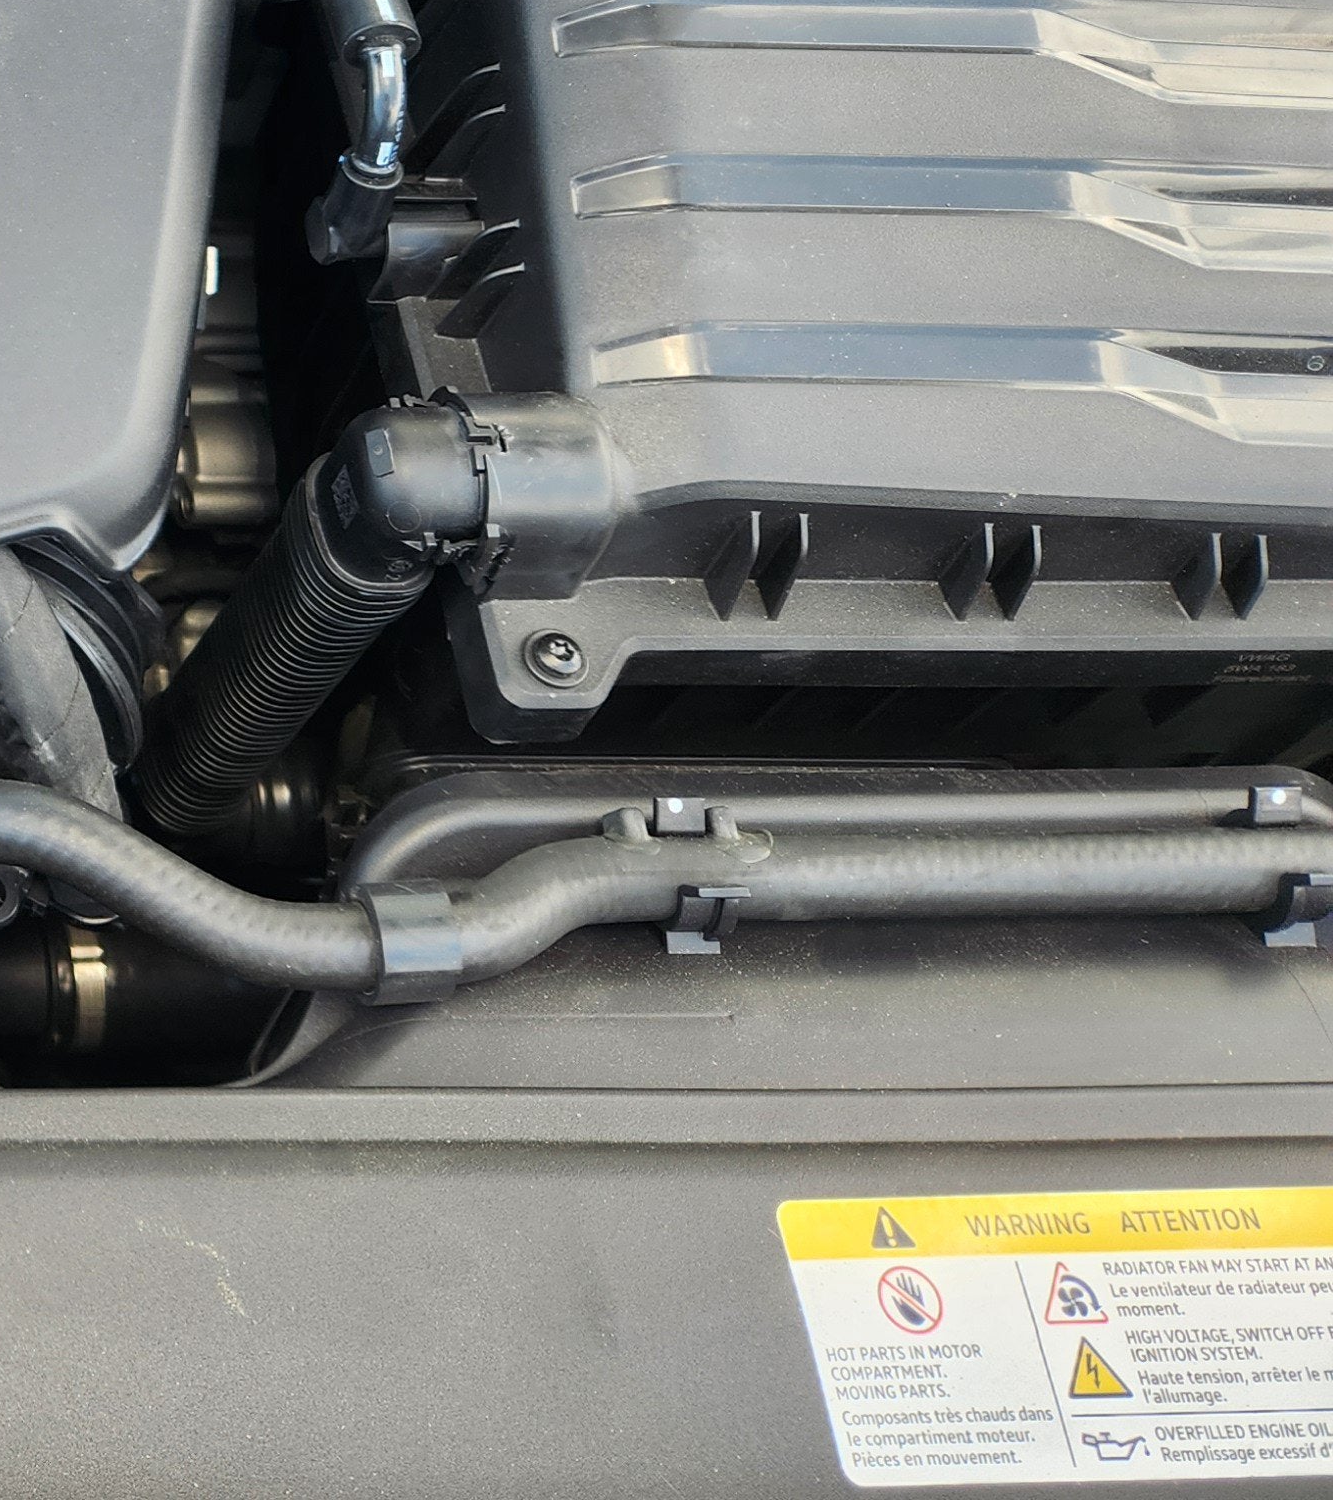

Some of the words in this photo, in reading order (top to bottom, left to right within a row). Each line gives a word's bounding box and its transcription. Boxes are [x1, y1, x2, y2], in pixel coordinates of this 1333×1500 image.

[964, 1212, 1090, 1236] WARNING
[1121, 1207, 1261, 1232] ATTENTION
[1101, 1260, 1177, 1275] RADIATOR
[1178, 1259, 1209, 1273] FAN
[1210, 1258, 1242, 1272] MAY
[1245, 1257, 1289, 1272] START
[1294, 1257, 1309, 1271] AT
[1108, 1283, 1128, 1297] Le
[1129, 1281, 1211, 1297] ventilateur
[1215, 1280, 1234, 1295] de
[1237, 1279, 1305, 1294] radiateur
[1115, 1302, 1185, 1316] moment.
[1124, 1329, 1162, 1344] HIGH
[1163, 1328, 1234, 1344] VOLTAGE,
[1235, 1326, 1294, 1341] SWITCH
[1296, 1325, 1324, 1340] OFF
[825, 1346, 854, 1361] HOT
[859, 1345, 905, 1360] PARTS
[908, 1345, 925, 1359] IN
[927, 1343, 982, 1359] MOTOR
[1130, 1346, 1198, 1362] IGNITION
[1199, 1345, 1262, 1361] SYSTEM.
[830, 1363, 947, 1381] COMPARTMENT.
[1137, 1370, 1184, 1385] Haute
[1186, 1368, 1248, 1385] tension,
[1251, 1366, 1302, 1382] arrêter
[1304, 1366, 1320, 1381] le
[835, 1384, 896, 1400] MOVING
[898, 1383, 950, 1398] PARTS.
[1142, 1388, 1227, 1404] l'allumage.
[841, 1410, 932, 1428] Composants
[933, 1406, 963, 1423] très
[965, 1406, 1016, 1422] chauds
[1018, 1405, 1053, 1421] dans
[846, 1431, 860, 1446] le
[865, 1429, 973, 1448] compartiment
[975, 1429, 1035, 1443] moteur.
[1154, 1424, 1245, 1440] OVERFILLED
[1247, 1423, 1306, 1438] ENGINE
[851, 1451, 900, 1467] Pièces
[903, 1454, 923, 1466] en
[925, 1450, 1022, 1465] mouvement.
[1160, 1445, 1255, 1465] Remplissage
[1258, 1442, 1316, 1459] excessif
